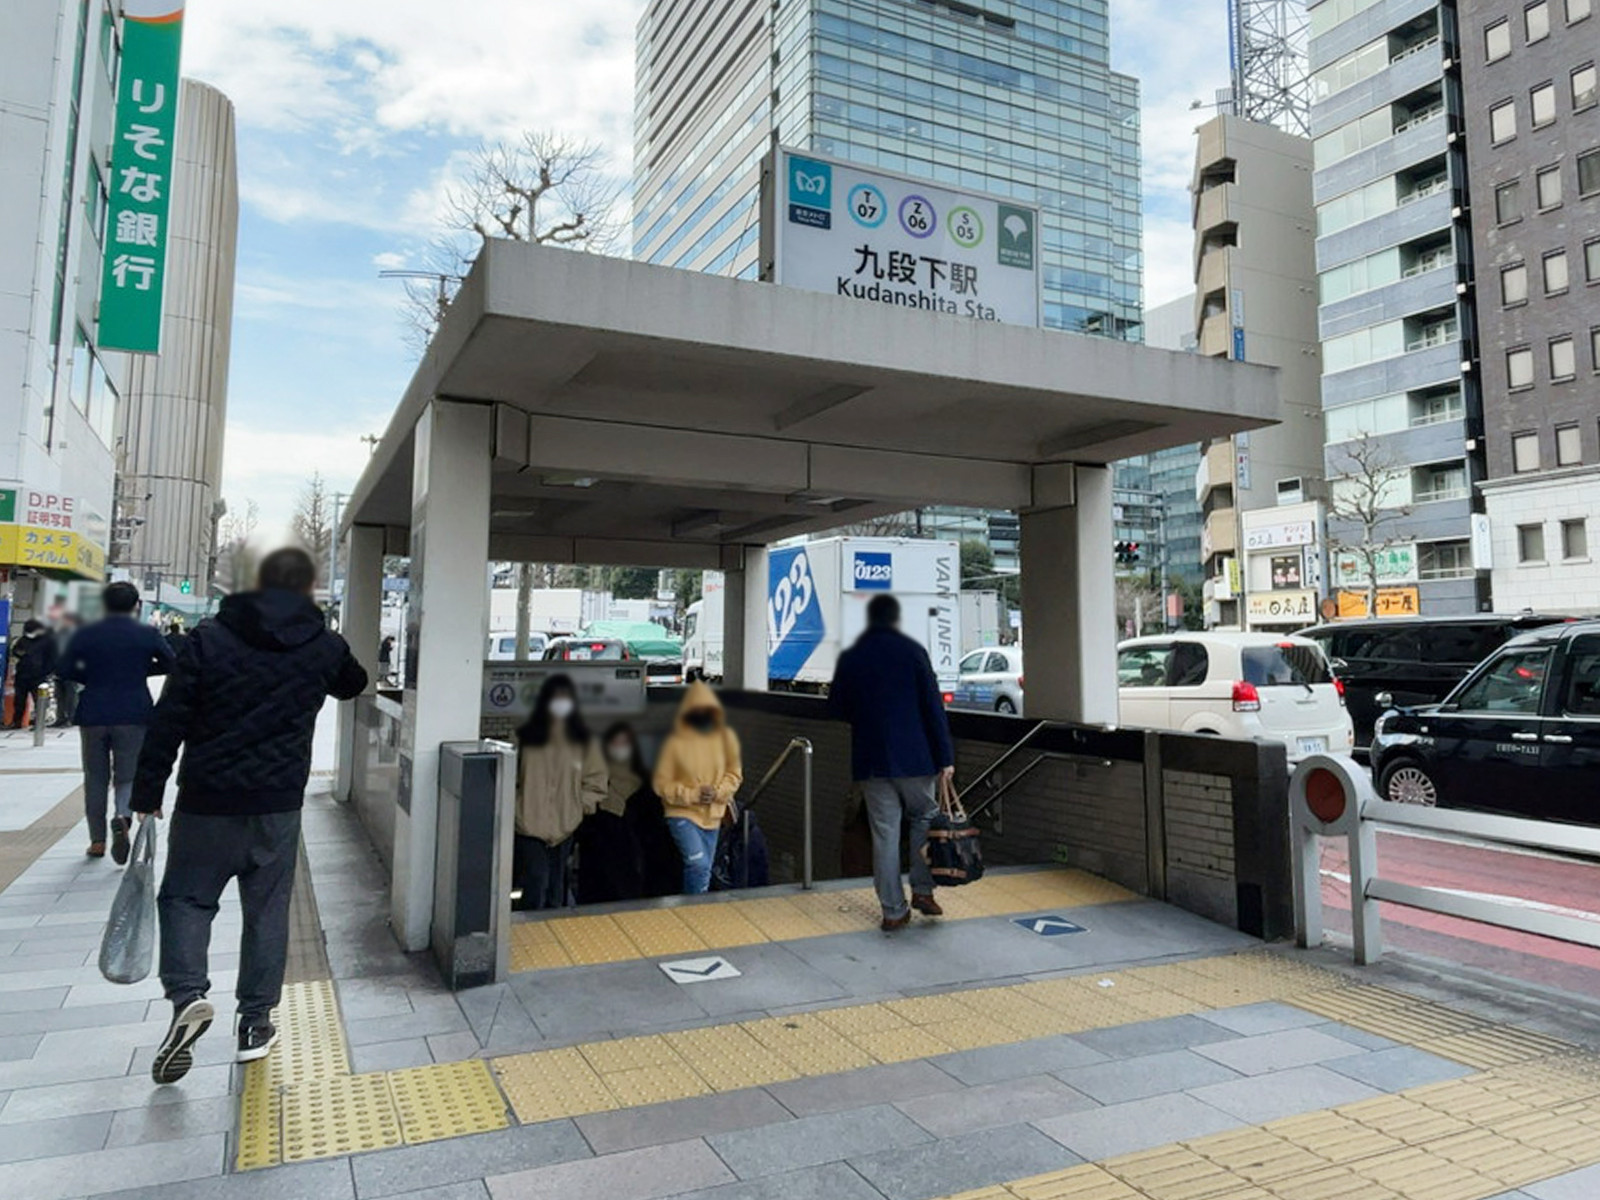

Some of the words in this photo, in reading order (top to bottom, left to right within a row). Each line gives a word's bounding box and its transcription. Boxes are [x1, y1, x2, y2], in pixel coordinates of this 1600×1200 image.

[112, 79, 165, 291] りそな銀行
[864, 191, 872, 203] T
[857, 203, 877, 219] 07
[913, 202, 922, 214] Z
[907, 214, 927, 230] 06
[962, 213, 970, 225] S
[956, 225, 974, 240] 05
[854, 244, 978, 296] 九段下駅
[837, 276, 957, 315] Kudanshita
[964, 299, 1001, 323] Sta.
[28, 491, 73, 513] D.P.E
[26, 532, 71, 548] カメラ
[936, 556, 951, 600] VAN
